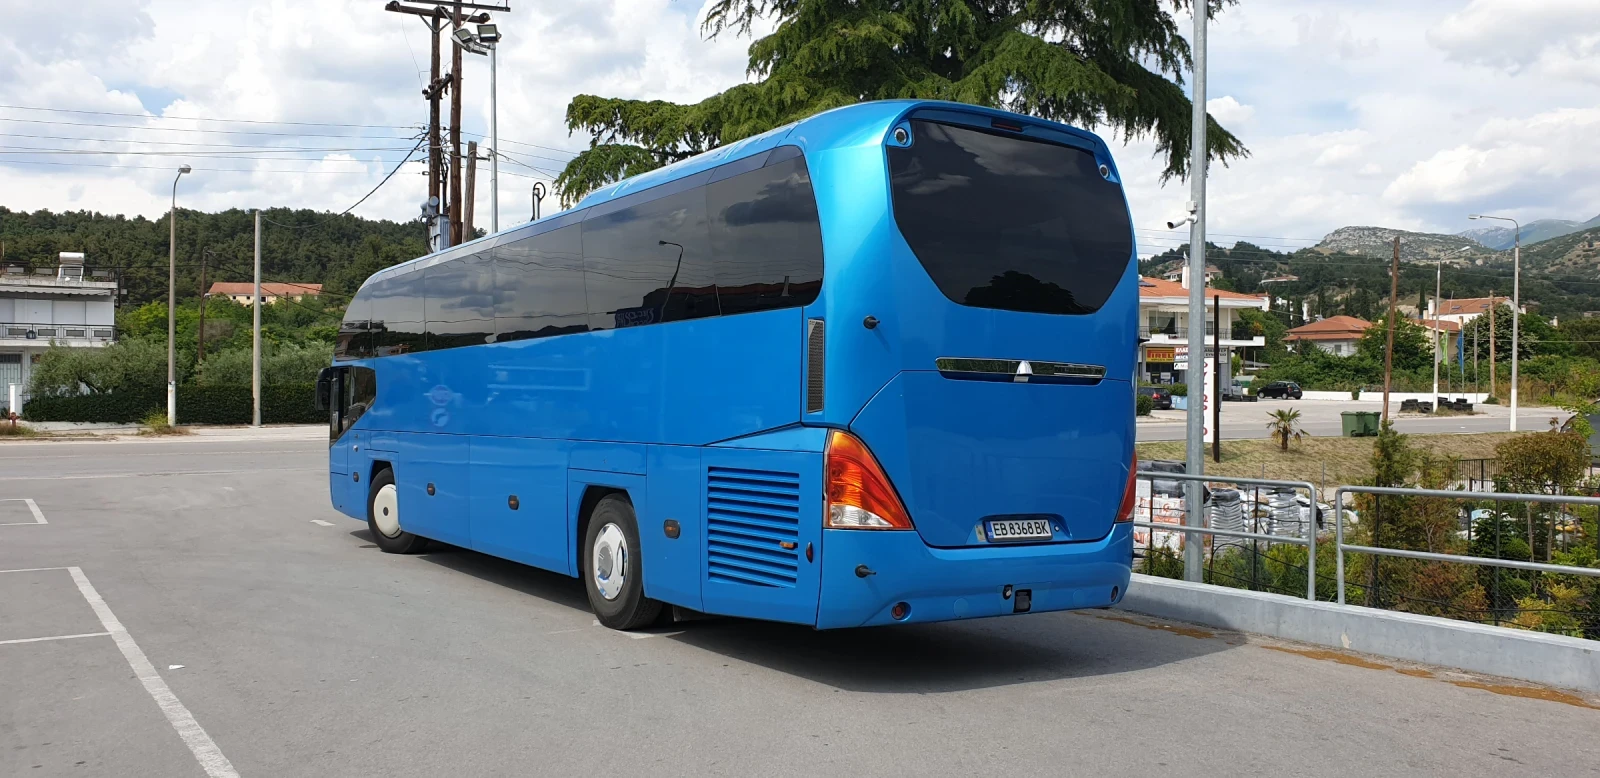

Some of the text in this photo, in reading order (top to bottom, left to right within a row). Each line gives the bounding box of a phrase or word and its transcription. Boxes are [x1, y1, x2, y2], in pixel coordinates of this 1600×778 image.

[993, 521, 1049, 536] EB 8368 BK
